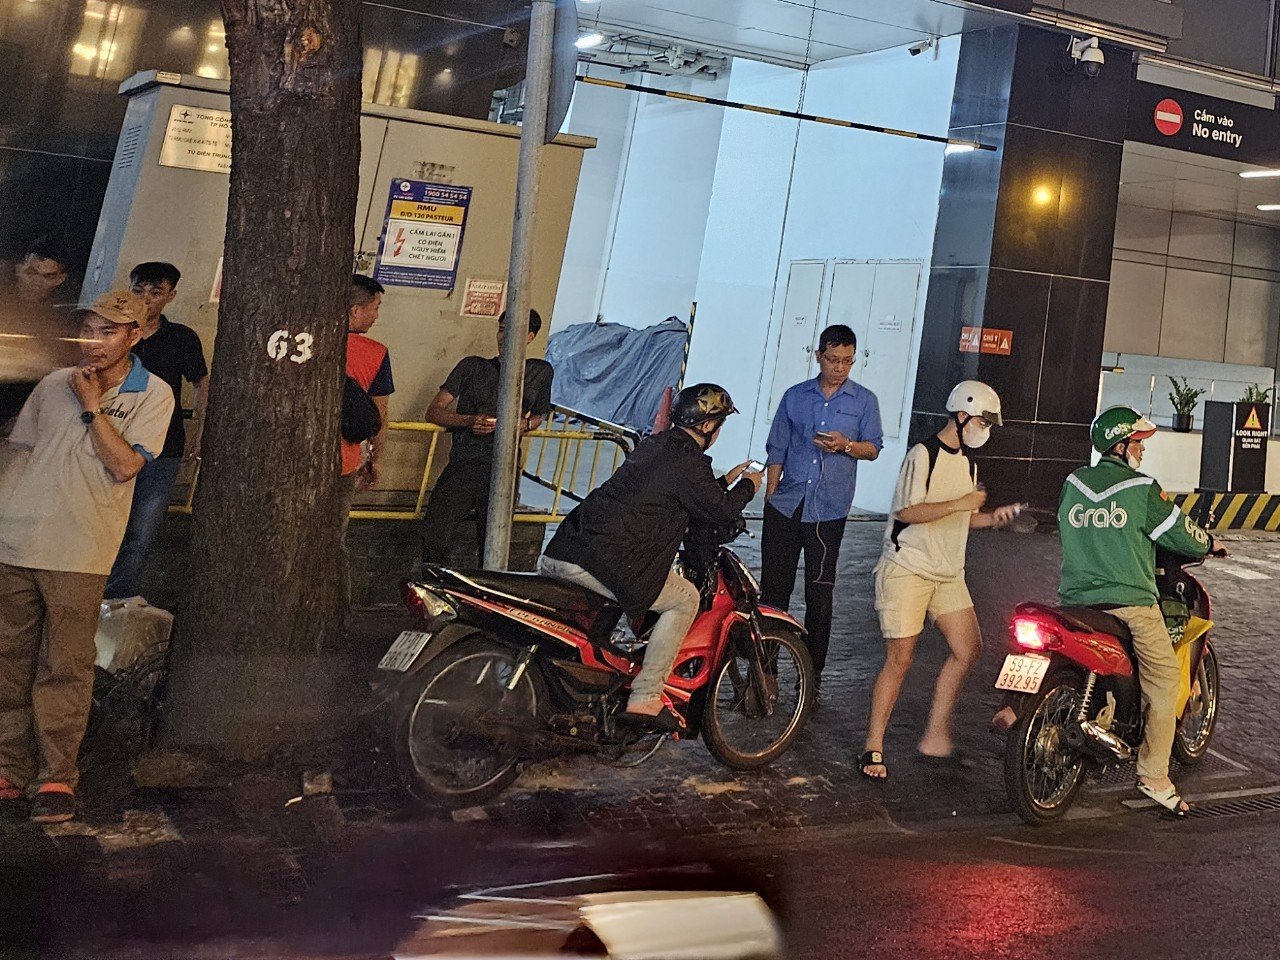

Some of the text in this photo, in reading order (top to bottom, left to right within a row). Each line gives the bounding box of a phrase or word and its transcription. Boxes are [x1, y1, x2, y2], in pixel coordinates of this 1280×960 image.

[1217, 115, 1234, 128] vào
[1192, 122, 1243, 148] No entry
[416, 204, 437, 212] RMU
[425, 214, 454, 222] PASTEUR
[267, 330, 313, 364] 63
[1068, 500, 1128, 529] Grab
[1009, 657, 1043, 675] 59-F2
[1000, 672, 1040, 691] 392.95
